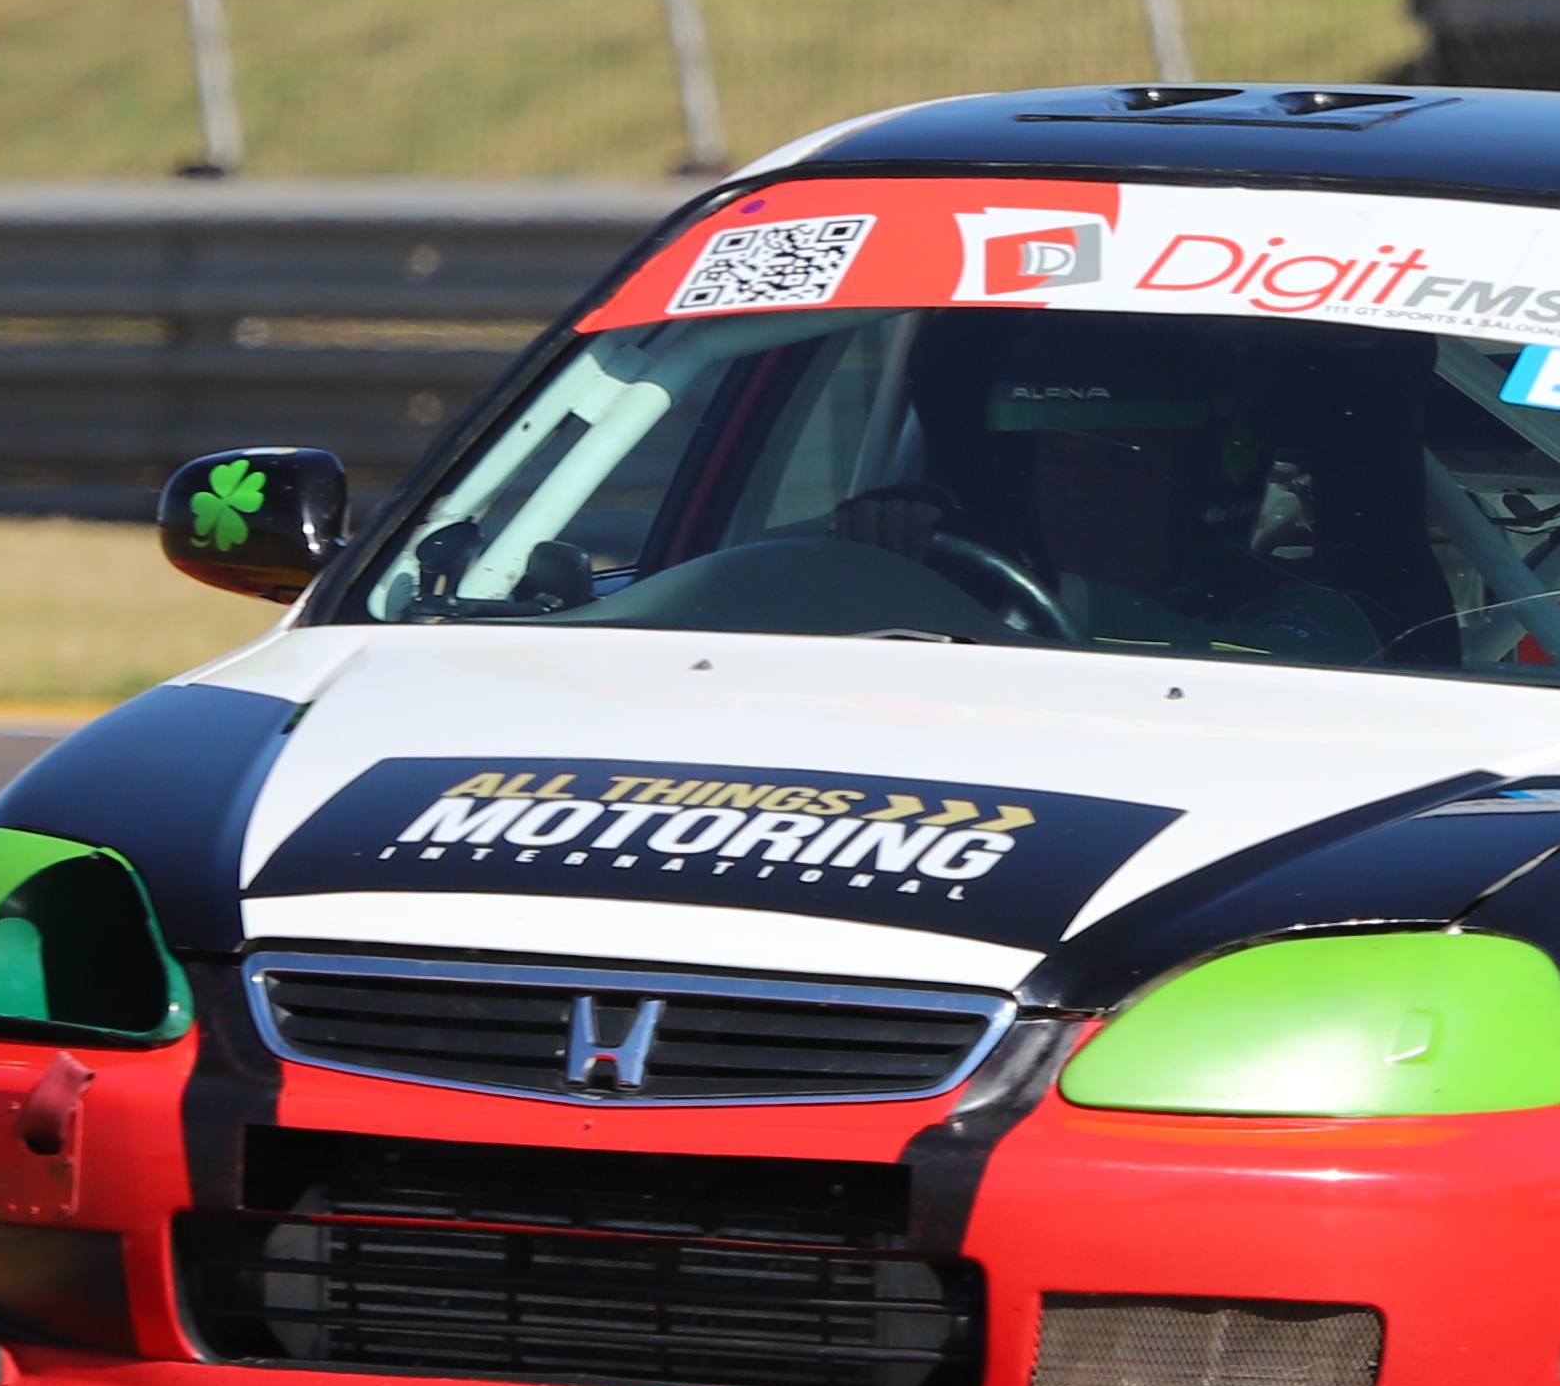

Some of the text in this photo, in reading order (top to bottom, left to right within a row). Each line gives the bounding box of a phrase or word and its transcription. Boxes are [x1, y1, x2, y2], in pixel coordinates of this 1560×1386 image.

[1354, 306, 1380, 317] GT
[1384, 309, 1458, 326] SPORTS
[443, 771, 867, 816] ALL THINGS
[395, 796, 1018, 881] MOTORING
[378, 845, 967, 901] INTERNATIONAL
